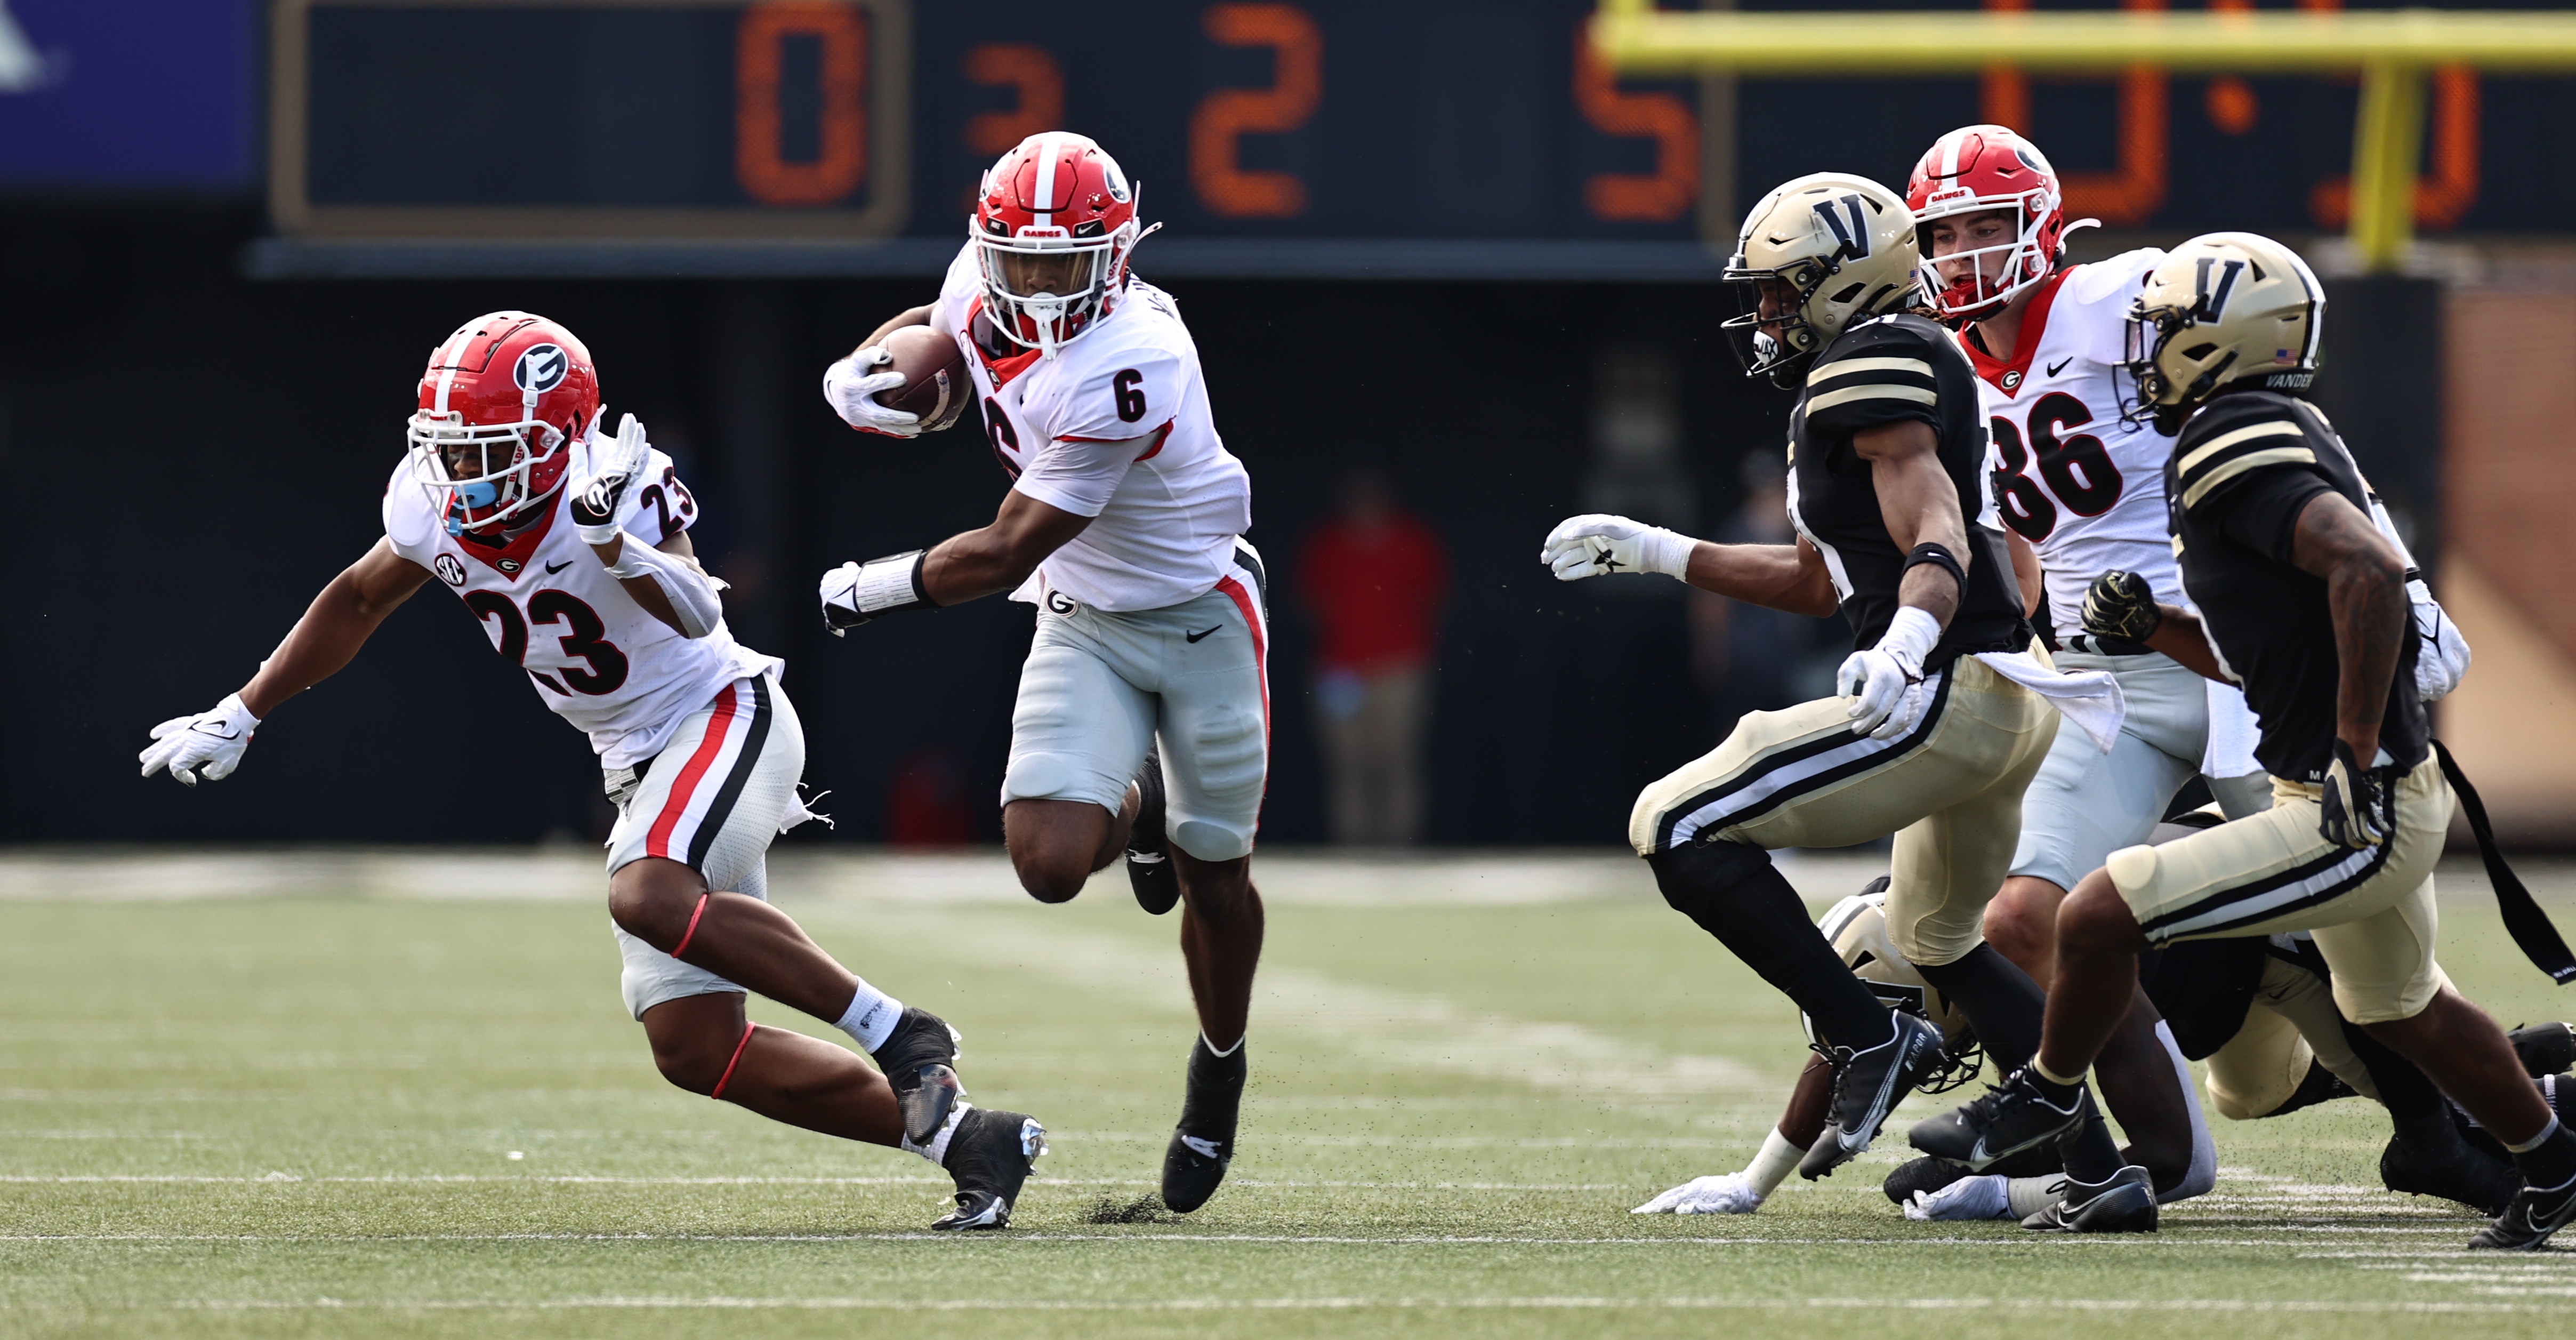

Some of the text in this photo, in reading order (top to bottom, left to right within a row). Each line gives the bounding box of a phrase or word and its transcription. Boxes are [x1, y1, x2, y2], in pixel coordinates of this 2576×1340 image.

[735, 0, 867, 207] 0
[1189, 2, 1324, 220] 2
[1812, 194, 1870, 262] V
[1931, 190, 1966, 202] DAWGS
[2195, 258, 2246, 325] V
[1113, 368, 1147, 423] 6
[2002, 372, 2020, 388] G
[1991, 391, 2123, 543] 86
[640, 467, 694, 540] 23
[436, 555, 464, 585] SEC
[497, 559, 520, 572] G
[1048, 590, 1076, 613] G
[462, 589, 629, 697] 23
